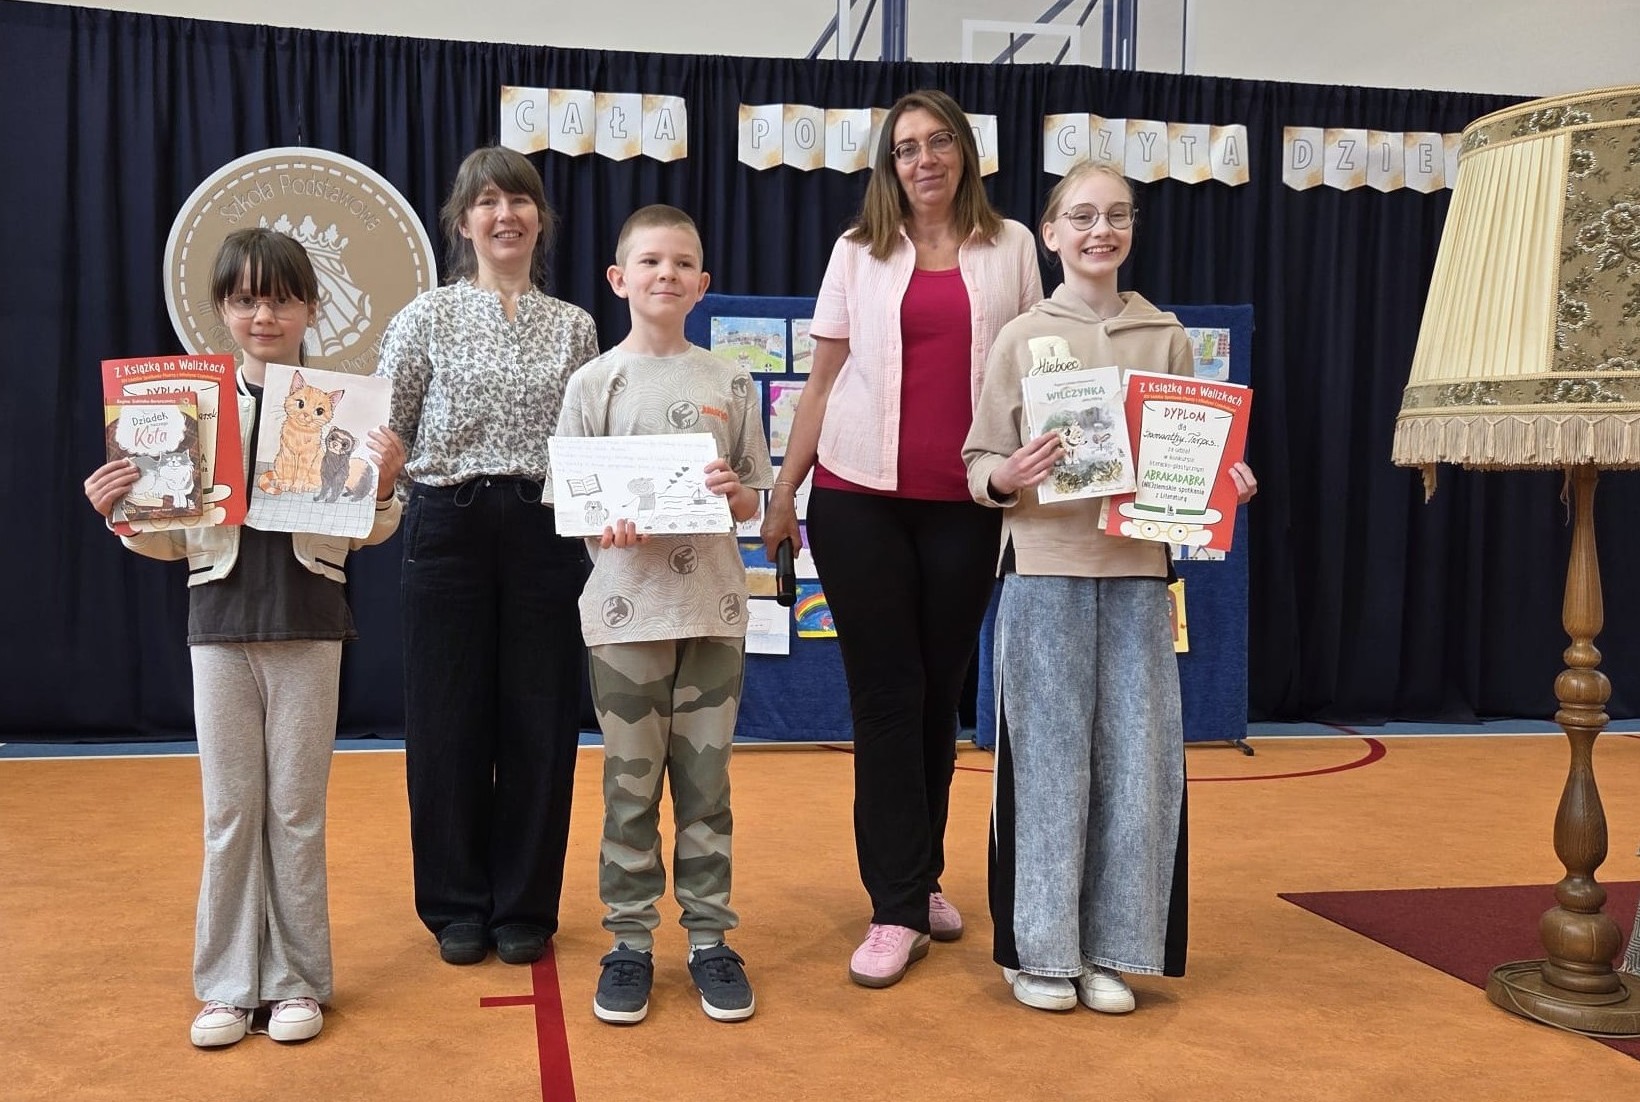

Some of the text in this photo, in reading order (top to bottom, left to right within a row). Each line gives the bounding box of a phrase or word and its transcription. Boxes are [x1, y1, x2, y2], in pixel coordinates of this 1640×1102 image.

[515, 100, 1433, 174] CAŁA POLA CZYTA DZIE
[279, 173, 382, 232] Podstawowa
[164, 360, 175, 371] na
[179, 359, 226, 374] Walizkach
[1046, 386, 1106, 402] WILCZYNKA
[1186, 386, 1196, 395] na
[1200, 385, 1243, 407] Walizkach
[132, 411, 169, 427] Dziadek
[1164, 407, 1206, 422] DYPLOM
[1143, 469, 1206, 487] ABRAKADABRA
